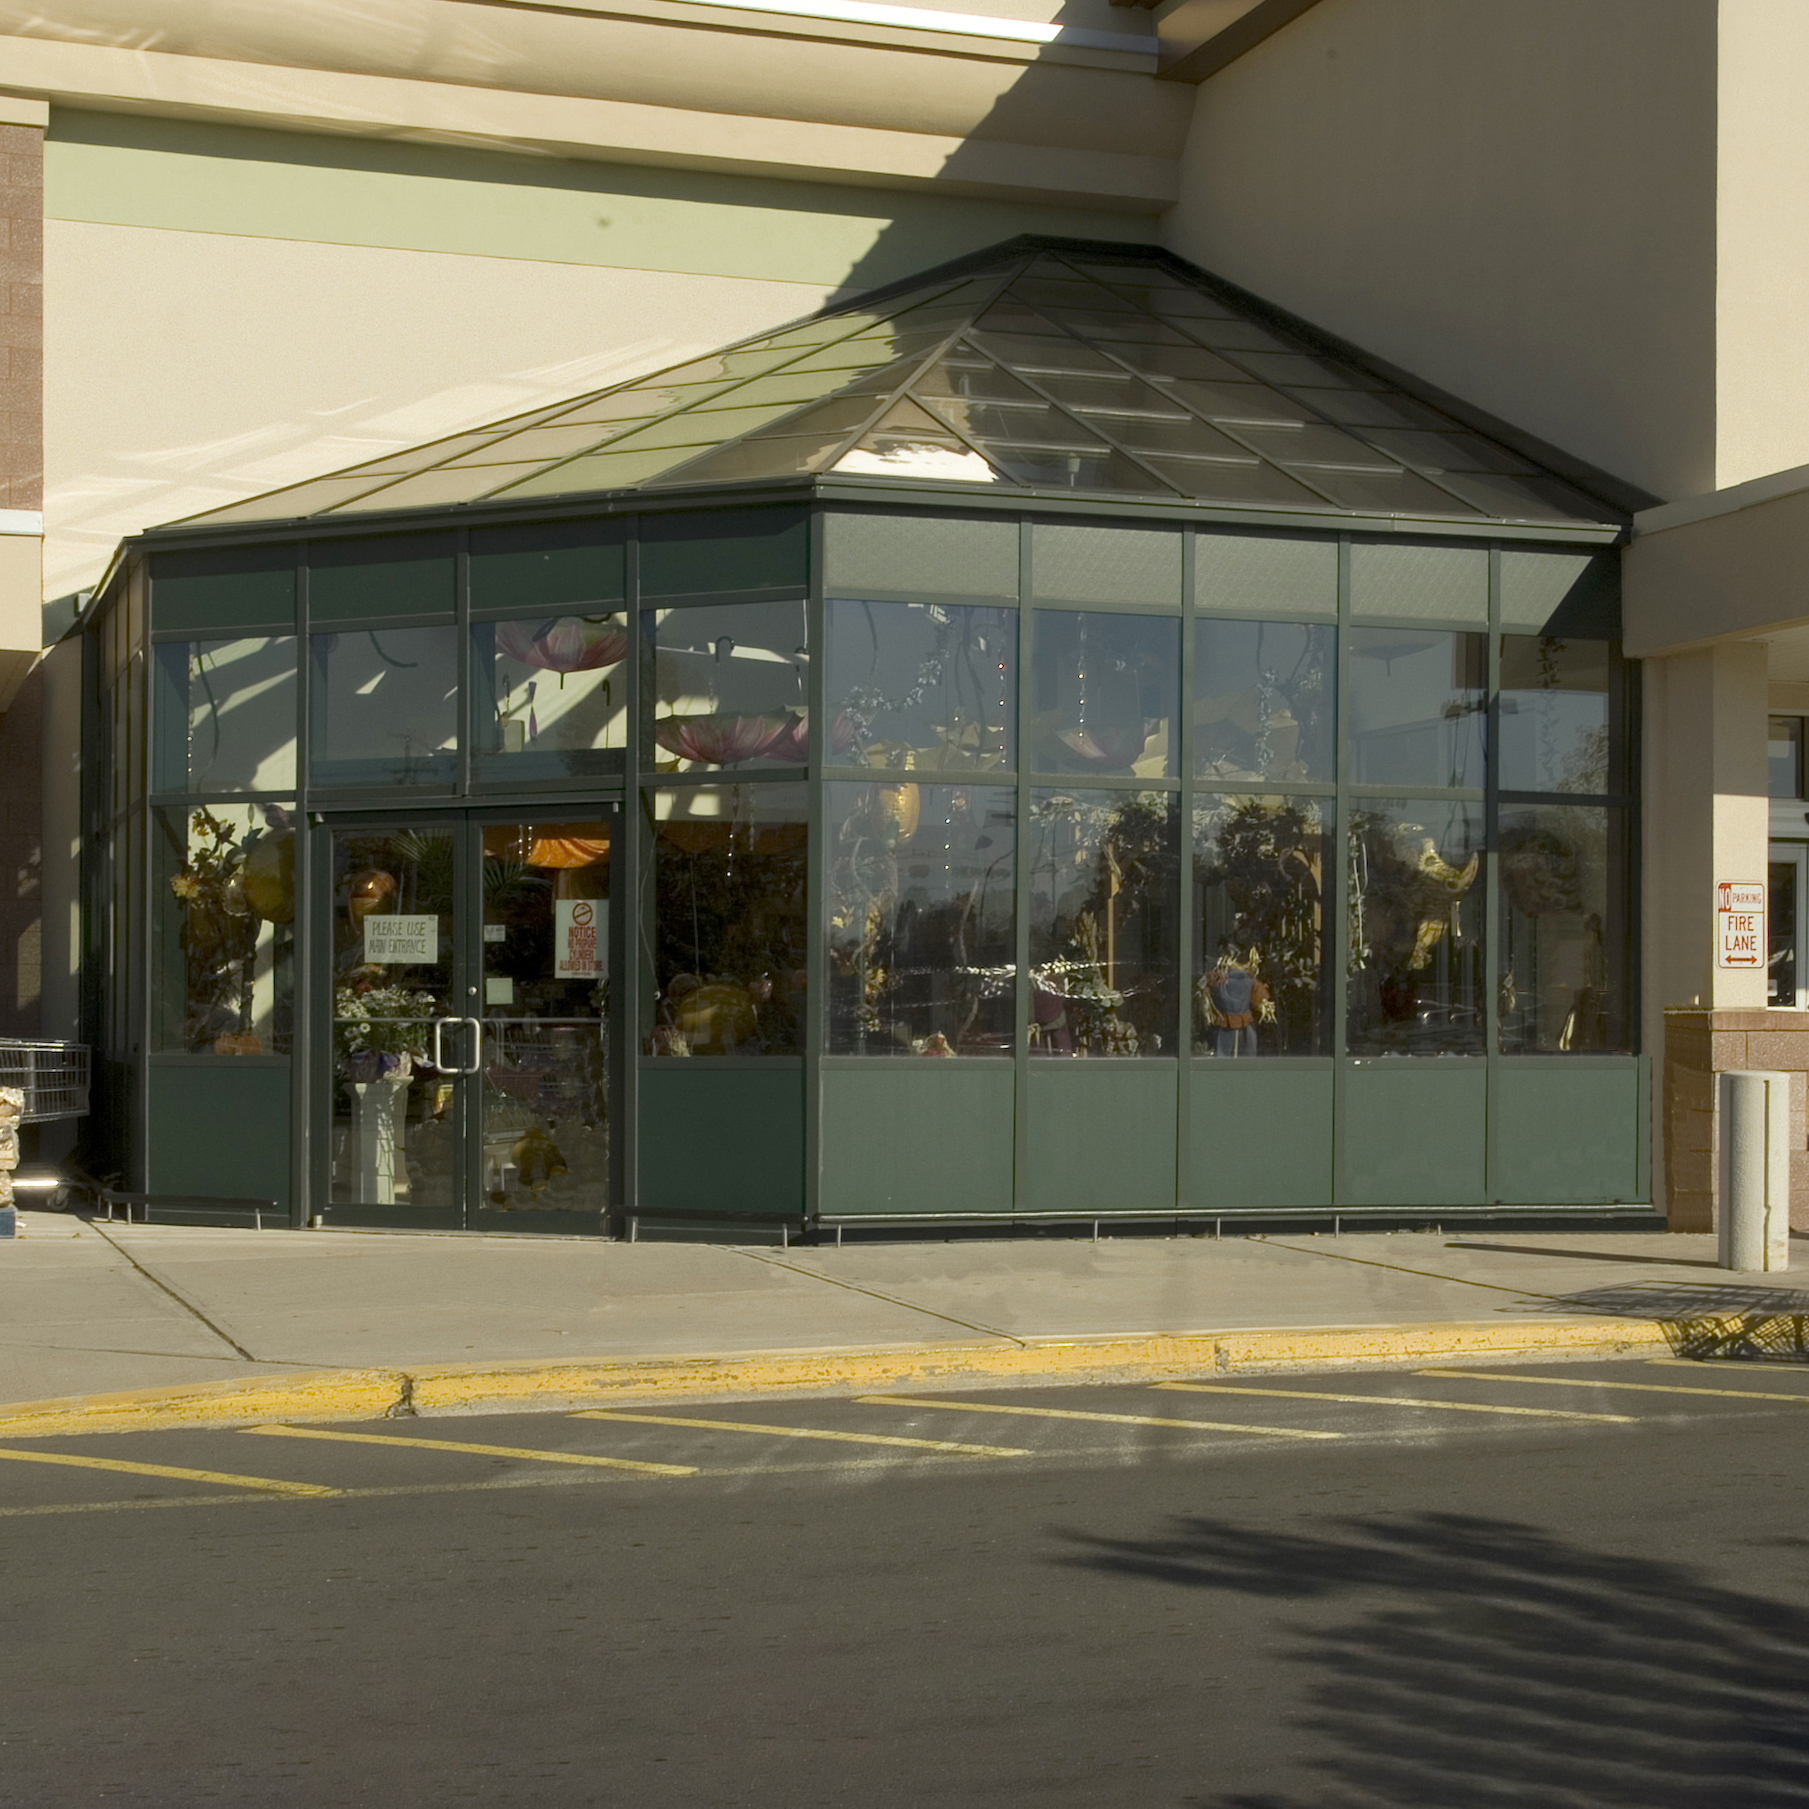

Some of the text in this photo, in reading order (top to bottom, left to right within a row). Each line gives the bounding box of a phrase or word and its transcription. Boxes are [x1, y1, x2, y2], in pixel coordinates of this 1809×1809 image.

[1718, 888, 1761, 909] NO PARKING
[372, 921, 426, 936] PLEASE USE
[1728, 915, 1754, 931] FIRE
[568, 926, 596, 938] NOTICE
[369, 939, 426, 954] MAIN ENTRANCE
[1725, 935, 1757, 951] LANE
